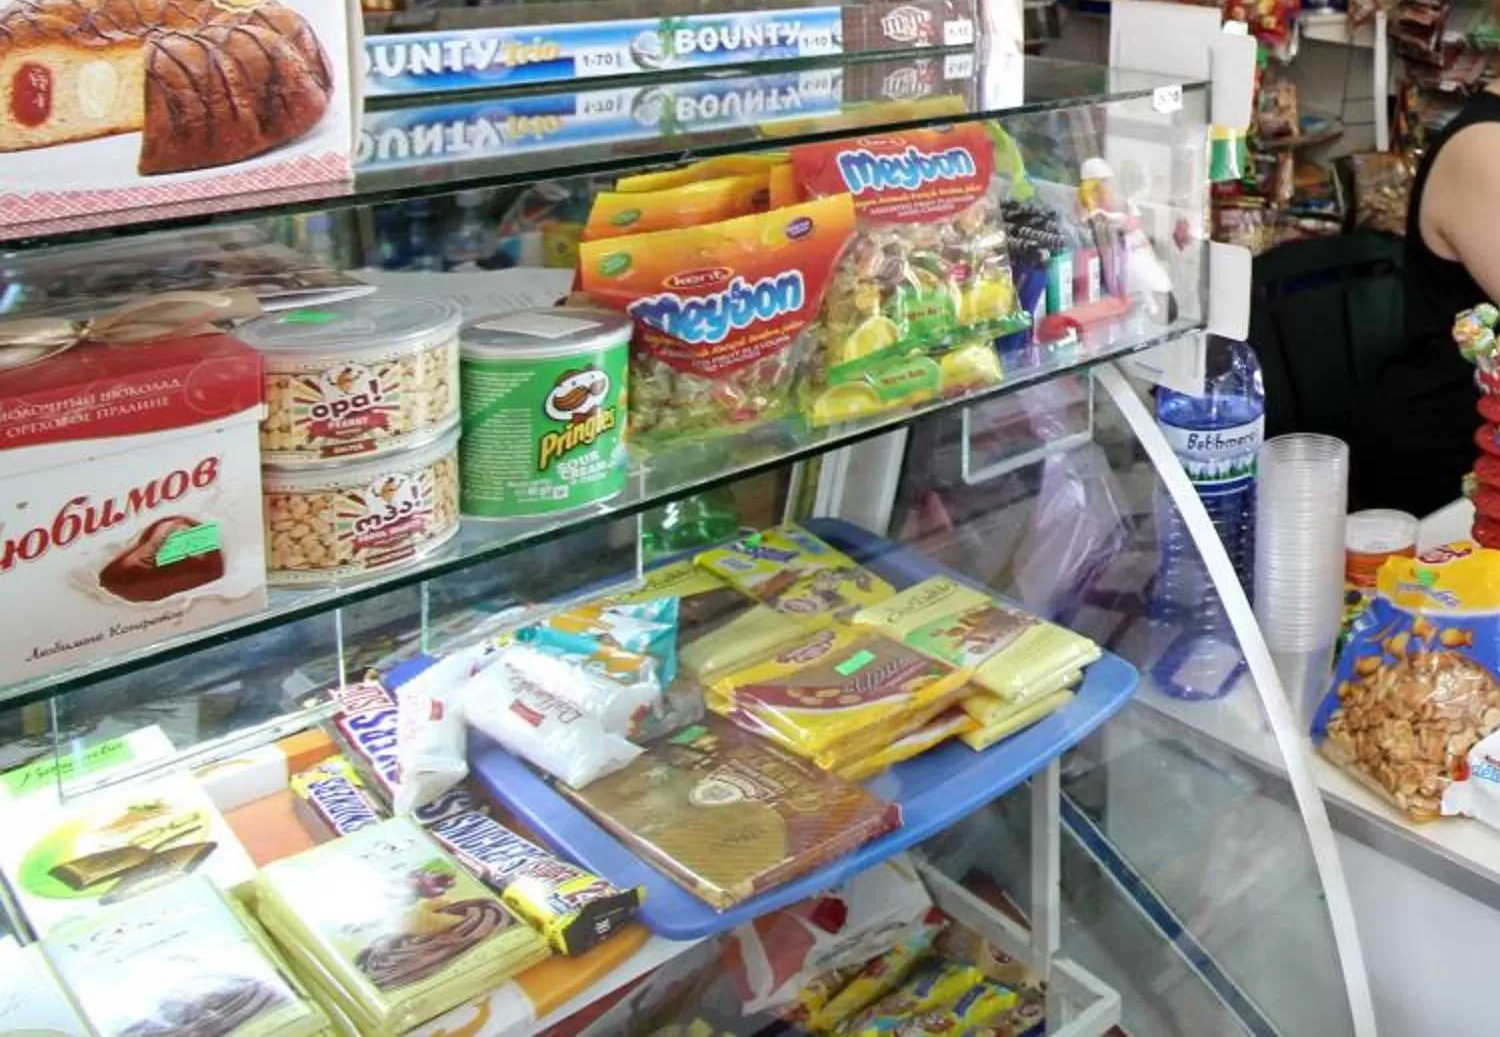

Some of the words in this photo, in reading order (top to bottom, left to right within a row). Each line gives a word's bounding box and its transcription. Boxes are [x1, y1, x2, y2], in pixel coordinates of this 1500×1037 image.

[366, 38, 503, 77] UNTY
[675, 21, 800, 54] BOUNTY
[538, 408, 617, 472] Pringles
[0, 455, 220, 571] юбимов
